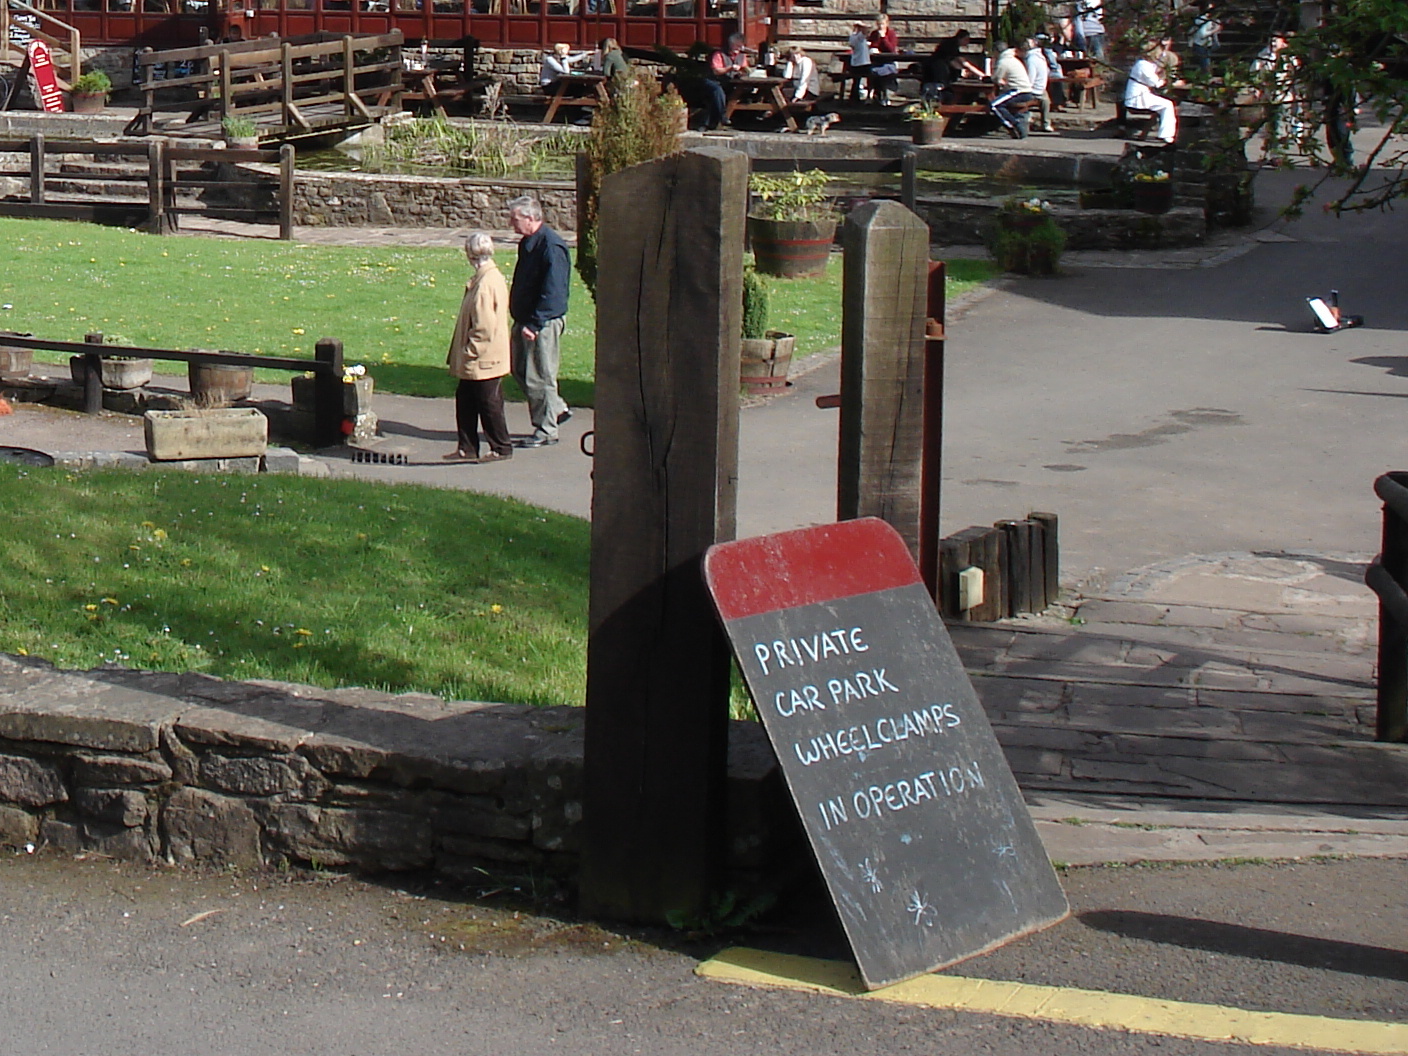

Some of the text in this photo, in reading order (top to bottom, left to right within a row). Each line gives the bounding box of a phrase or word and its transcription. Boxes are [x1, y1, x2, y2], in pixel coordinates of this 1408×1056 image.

[754, 626, 870, 676] PRIVATE
[775, 668, 900, 718] CAR PARK
[818, 761, 986, 831] IN OPERATION
